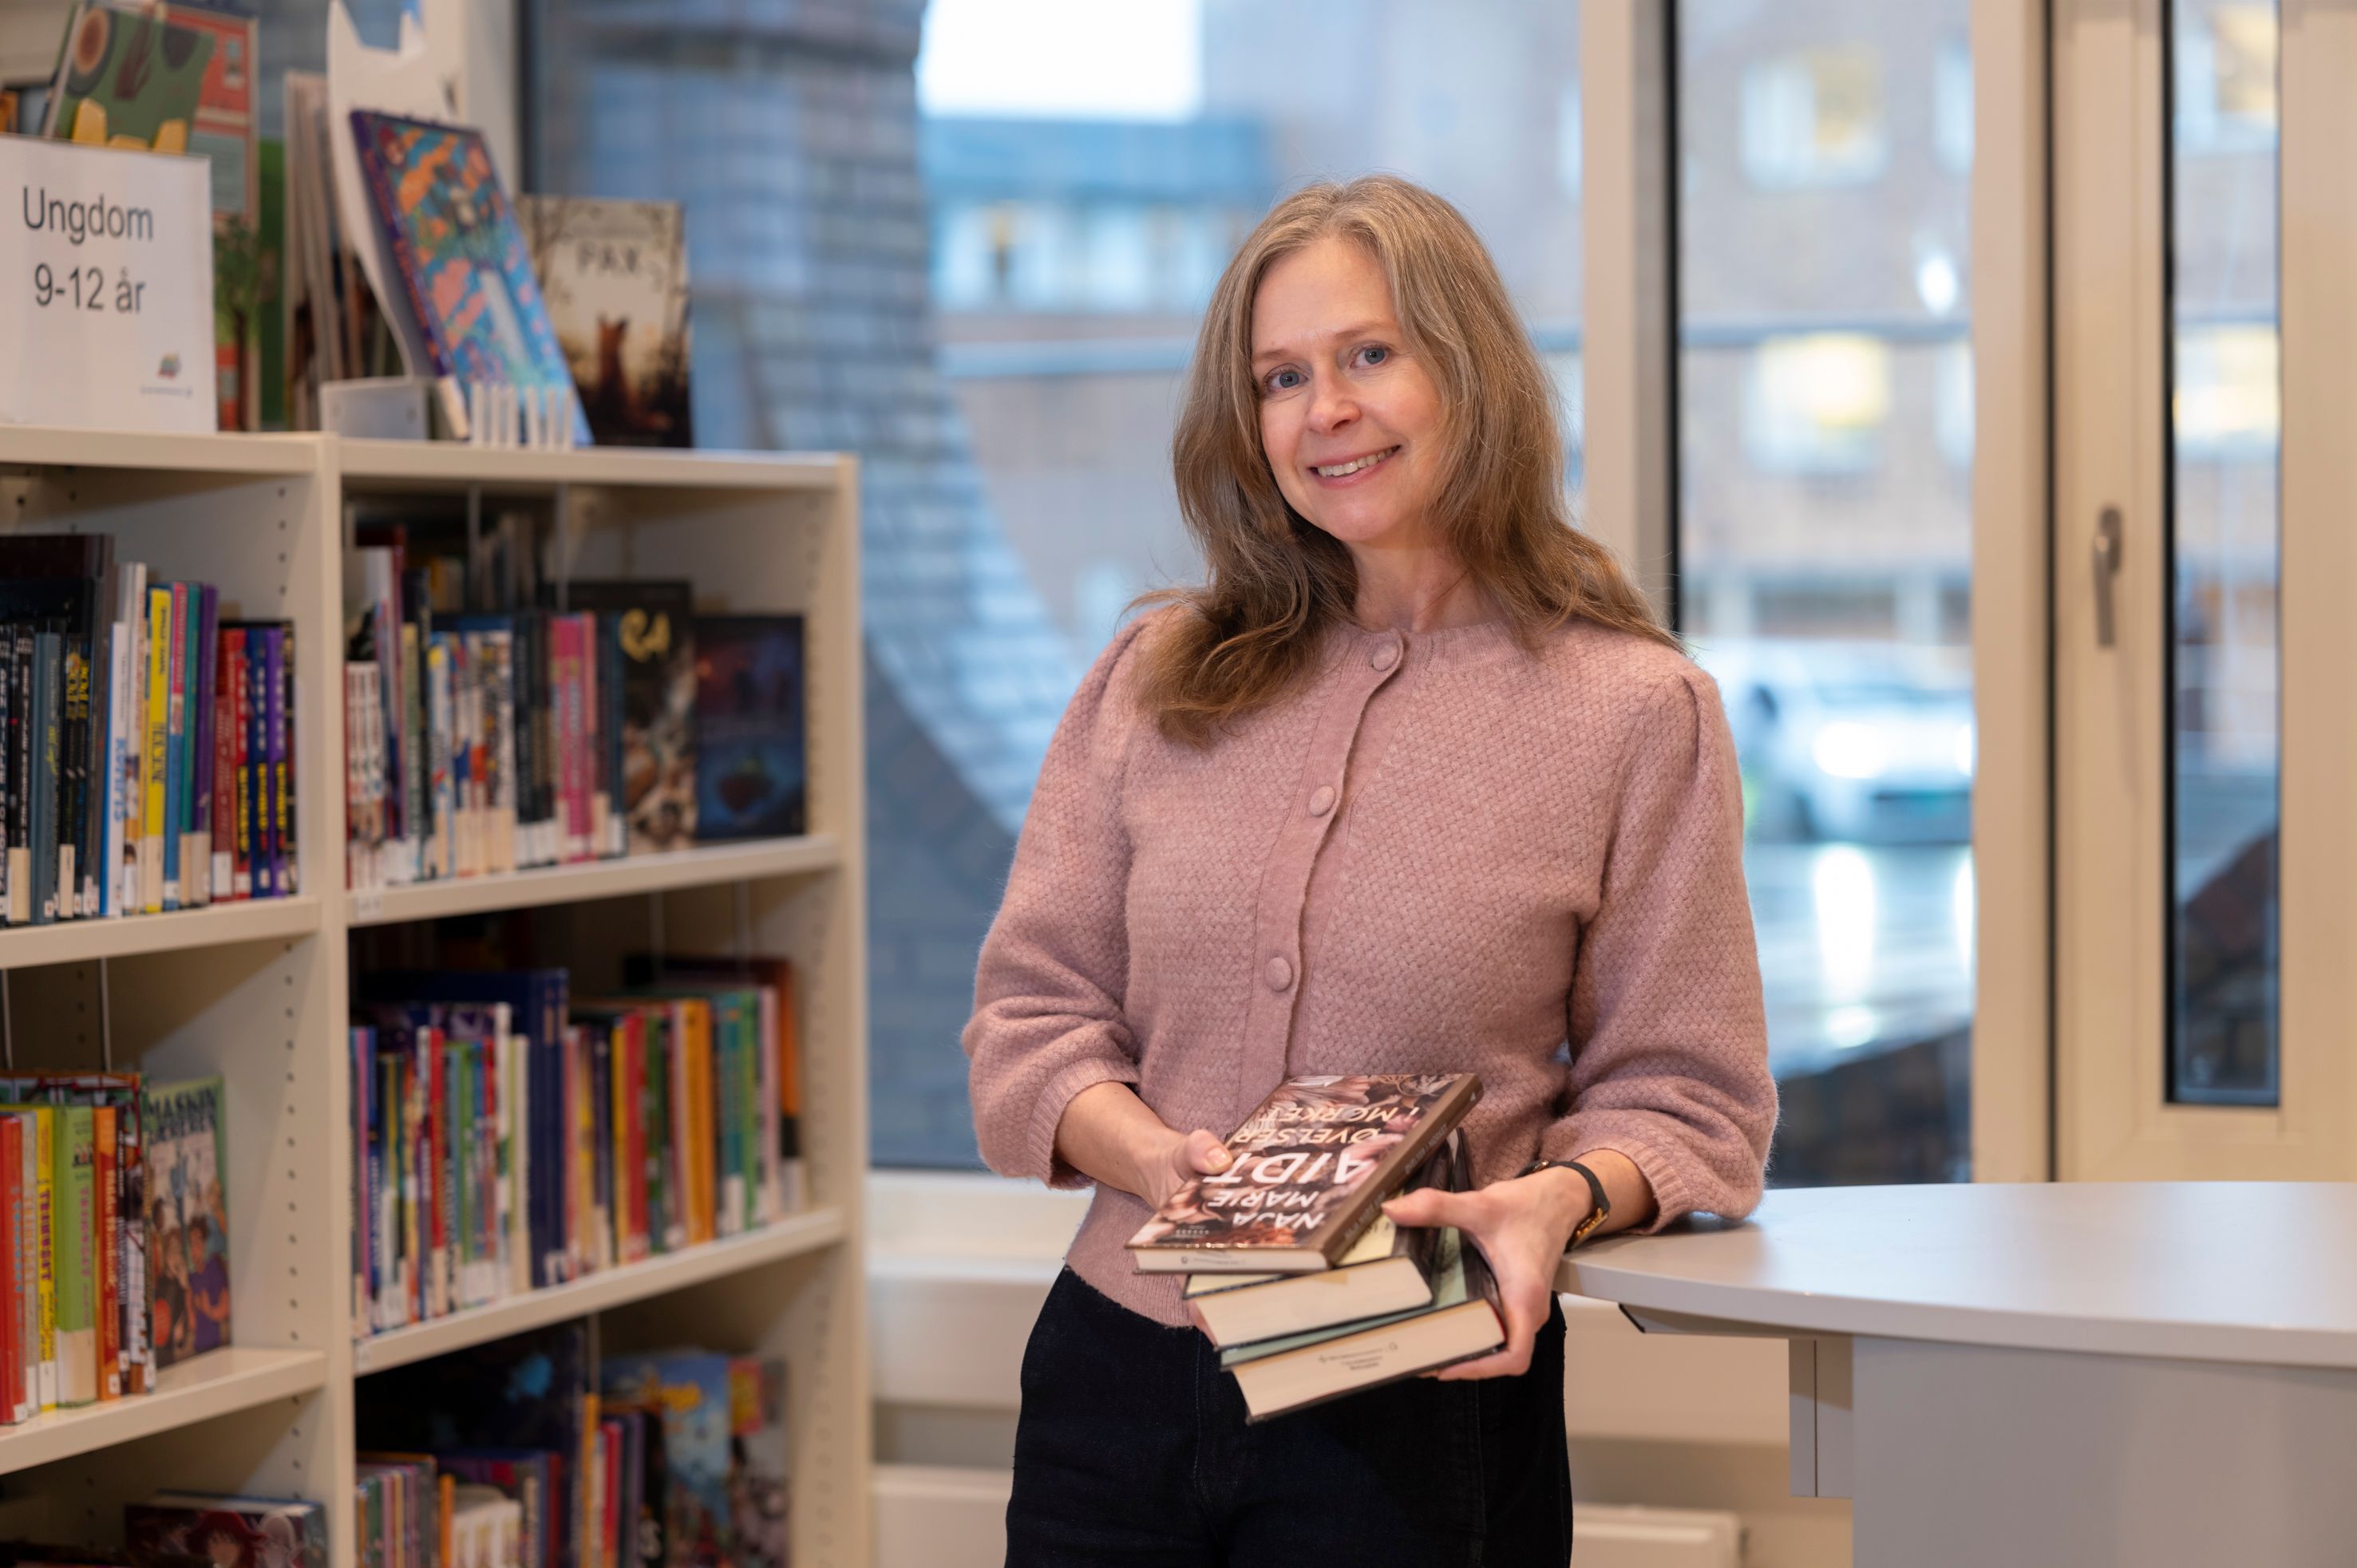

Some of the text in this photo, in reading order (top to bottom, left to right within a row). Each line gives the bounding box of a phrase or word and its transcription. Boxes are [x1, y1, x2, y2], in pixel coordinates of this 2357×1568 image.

[23, 185, 153, 245] Ungdom
[34, 262, 146, 314] 9-12 år
[1235, 1128, 1382, 1144] ØVELSER
[1202, 1152, 1378, 1184] AIDT
[1208, 1191, 1320, 1208] MARIE
[1232, 1212, 1327, 1230] NAJA
